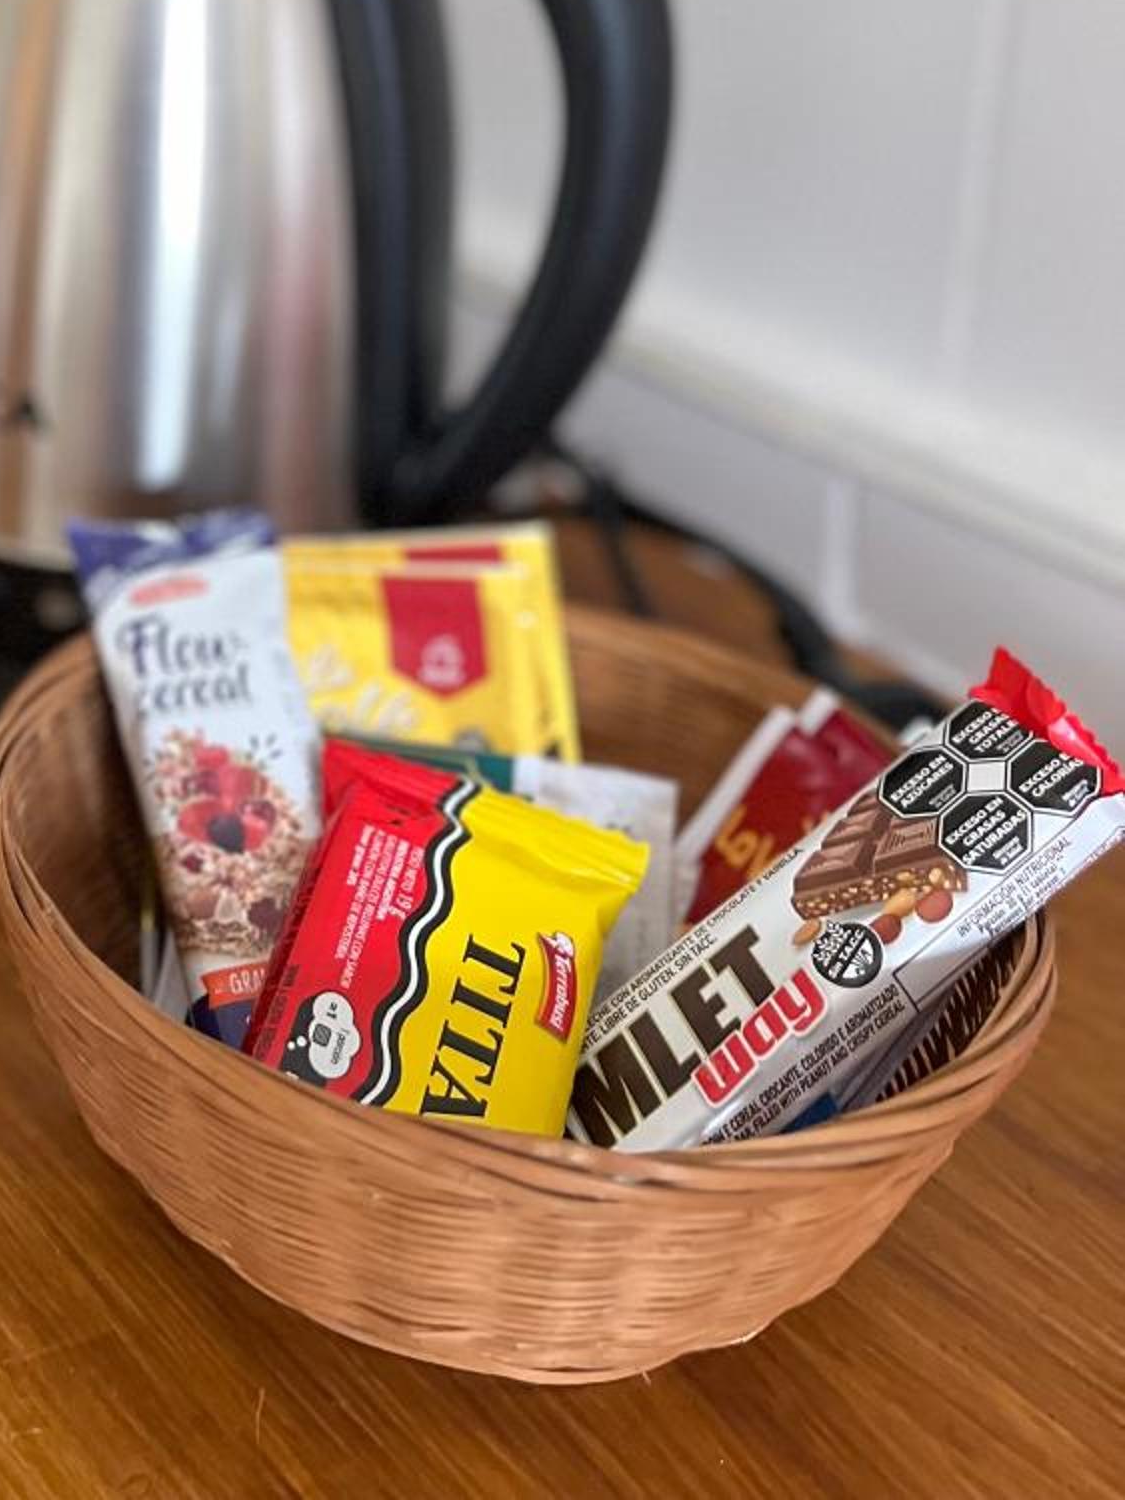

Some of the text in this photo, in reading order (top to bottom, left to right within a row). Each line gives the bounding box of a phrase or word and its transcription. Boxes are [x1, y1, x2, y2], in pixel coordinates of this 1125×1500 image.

[951, 709, 993, 745] EXCESO
[973, 716, 1019, 755] TOTALE
[889, 765, 931, 802] EXCESO
[928, 752, 946, 770] EN
[1018, 757, 1061, 794] EXCESO
[944, 807, 987, 846] EXCESO
[984, 794, 1003, 813] EN
[961, 808, 1006, 848] GRASAS
[961, 808, 1027, 866] SATURADAS
[399, 866, 418, 893] NETO
[1014, 834, 1071, 887] NUTRICIONAL
[230, 968, 267, 995] GRA
[549, 954, 572, 1033] Terrabusi
[581, 1001, 612, 1030] ECHE
[609, 987, 631, 1007] CON
[628, 934, 695, 992] AROMATIZANTE
[693, 924, 707, 938] DE
[597, 1006, 627, 1035] LIBRE
[623, 995, 640, 1013] DE
[637, 965, 677, 1002] GLUTEN.
[673, 950, 695, 971] SIN
[690, 931, 717, 957] TACC.
[419, 933, 526, 1118] TITA
[563, 923, 775, 1148] MLET
[726, 1099, 761, 1131] CEREAL
[798, 1032, 841, 1071] COLORIDO
[840, 981, 900, 1035] AROMATIZADO
[777, 1085, 802, 1109] WITH
[796, 1060, 832, 1093] PEANUT
[827, 1045, 849, 1066] AND
[844, 1022, 877, 1052] CRISPY
[872, 997, 906, 1029] CEREAL
